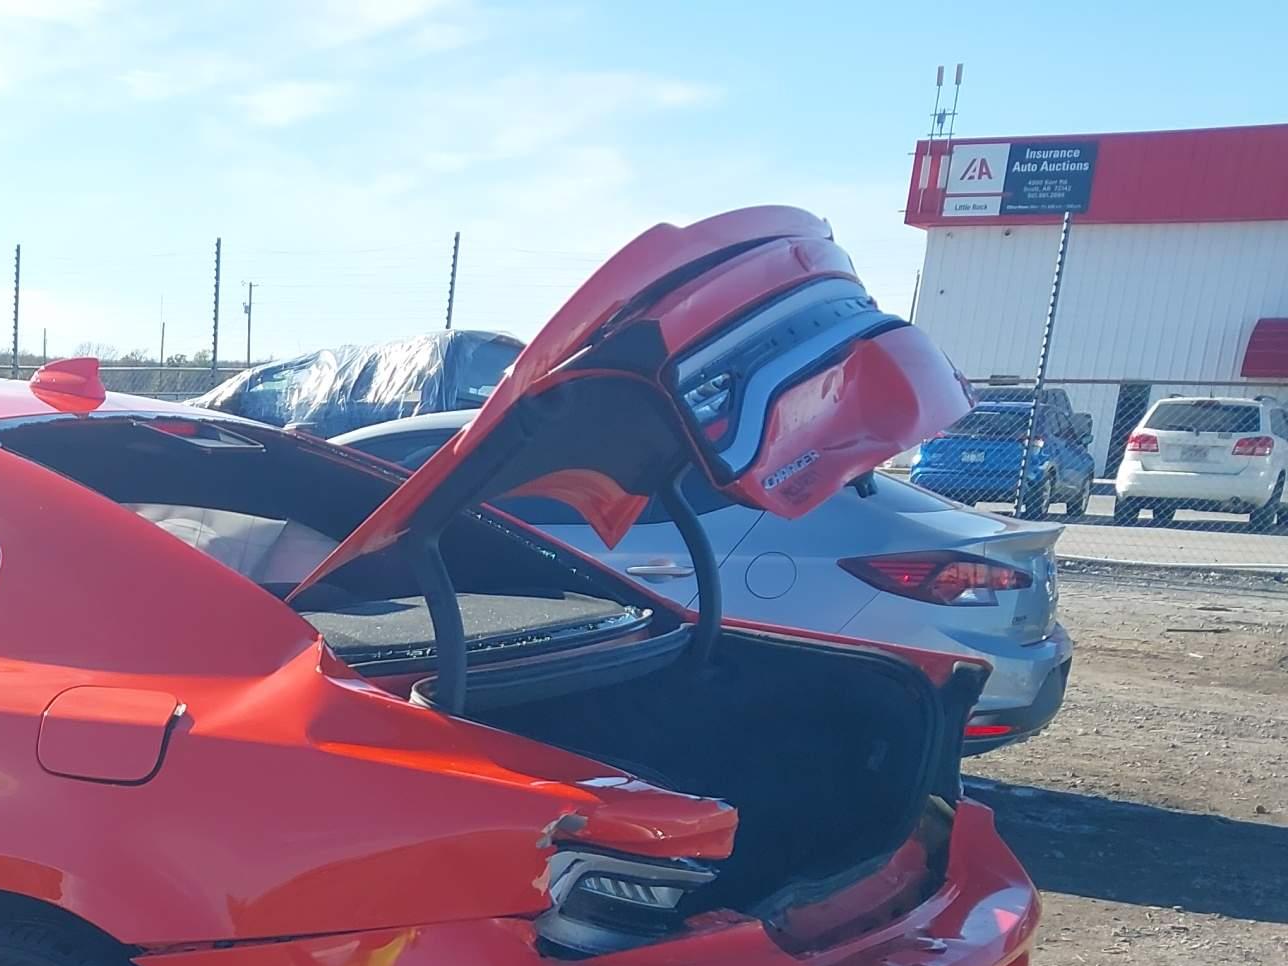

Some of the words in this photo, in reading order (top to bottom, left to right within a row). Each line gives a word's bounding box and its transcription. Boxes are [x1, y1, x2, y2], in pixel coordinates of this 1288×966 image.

[1026, 148, 1081, 159] Insurance
[1012, 161, 1038, 172] Auto
[1039, 160, 1090, 172] Auctions
[764, 450, 820, 489] CHARGER
